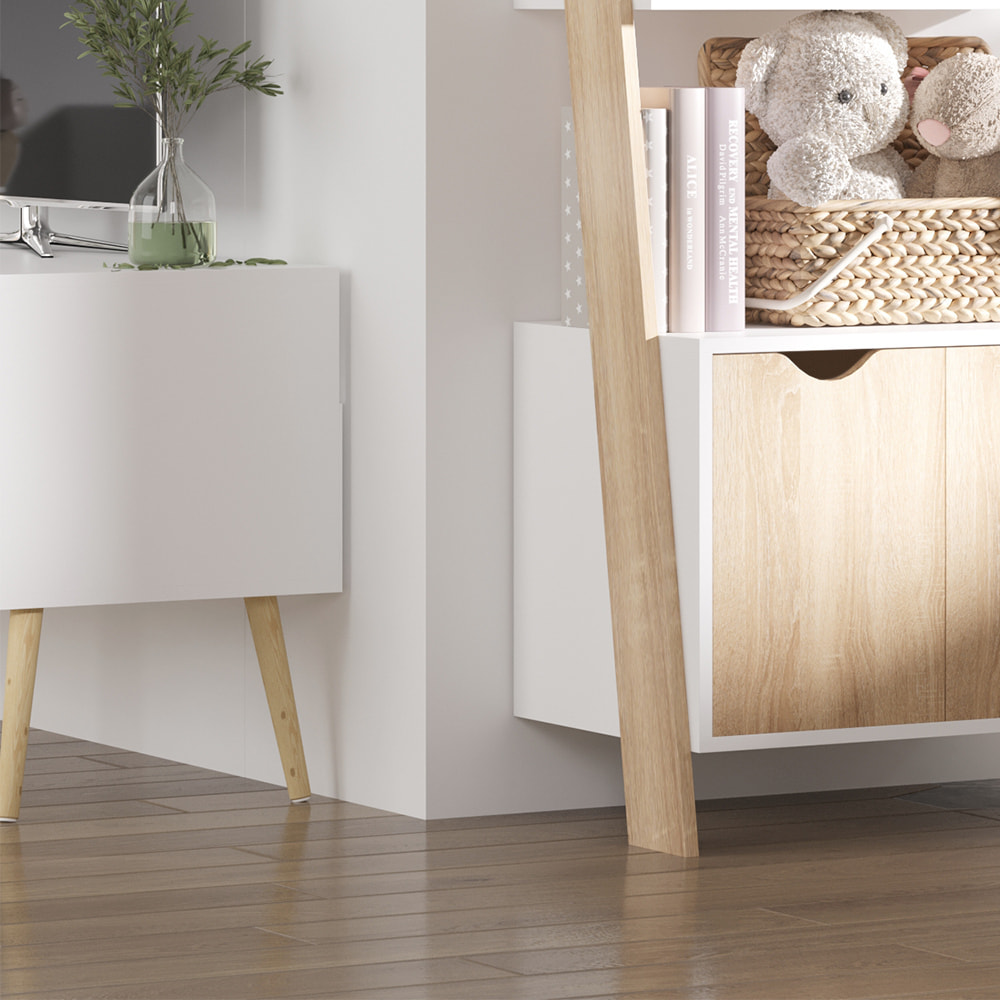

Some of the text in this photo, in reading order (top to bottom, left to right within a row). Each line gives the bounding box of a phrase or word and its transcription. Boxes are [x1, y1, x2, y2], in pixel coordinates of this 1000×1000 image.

[687, 154, 697, 199] ALICE
[717, 144, 727, 206] David Pilgrim
[728, 119, 739, 304] RECOVERY END MENTAL HEALTH
[719, 215, 727, 281] Ann McCranie
